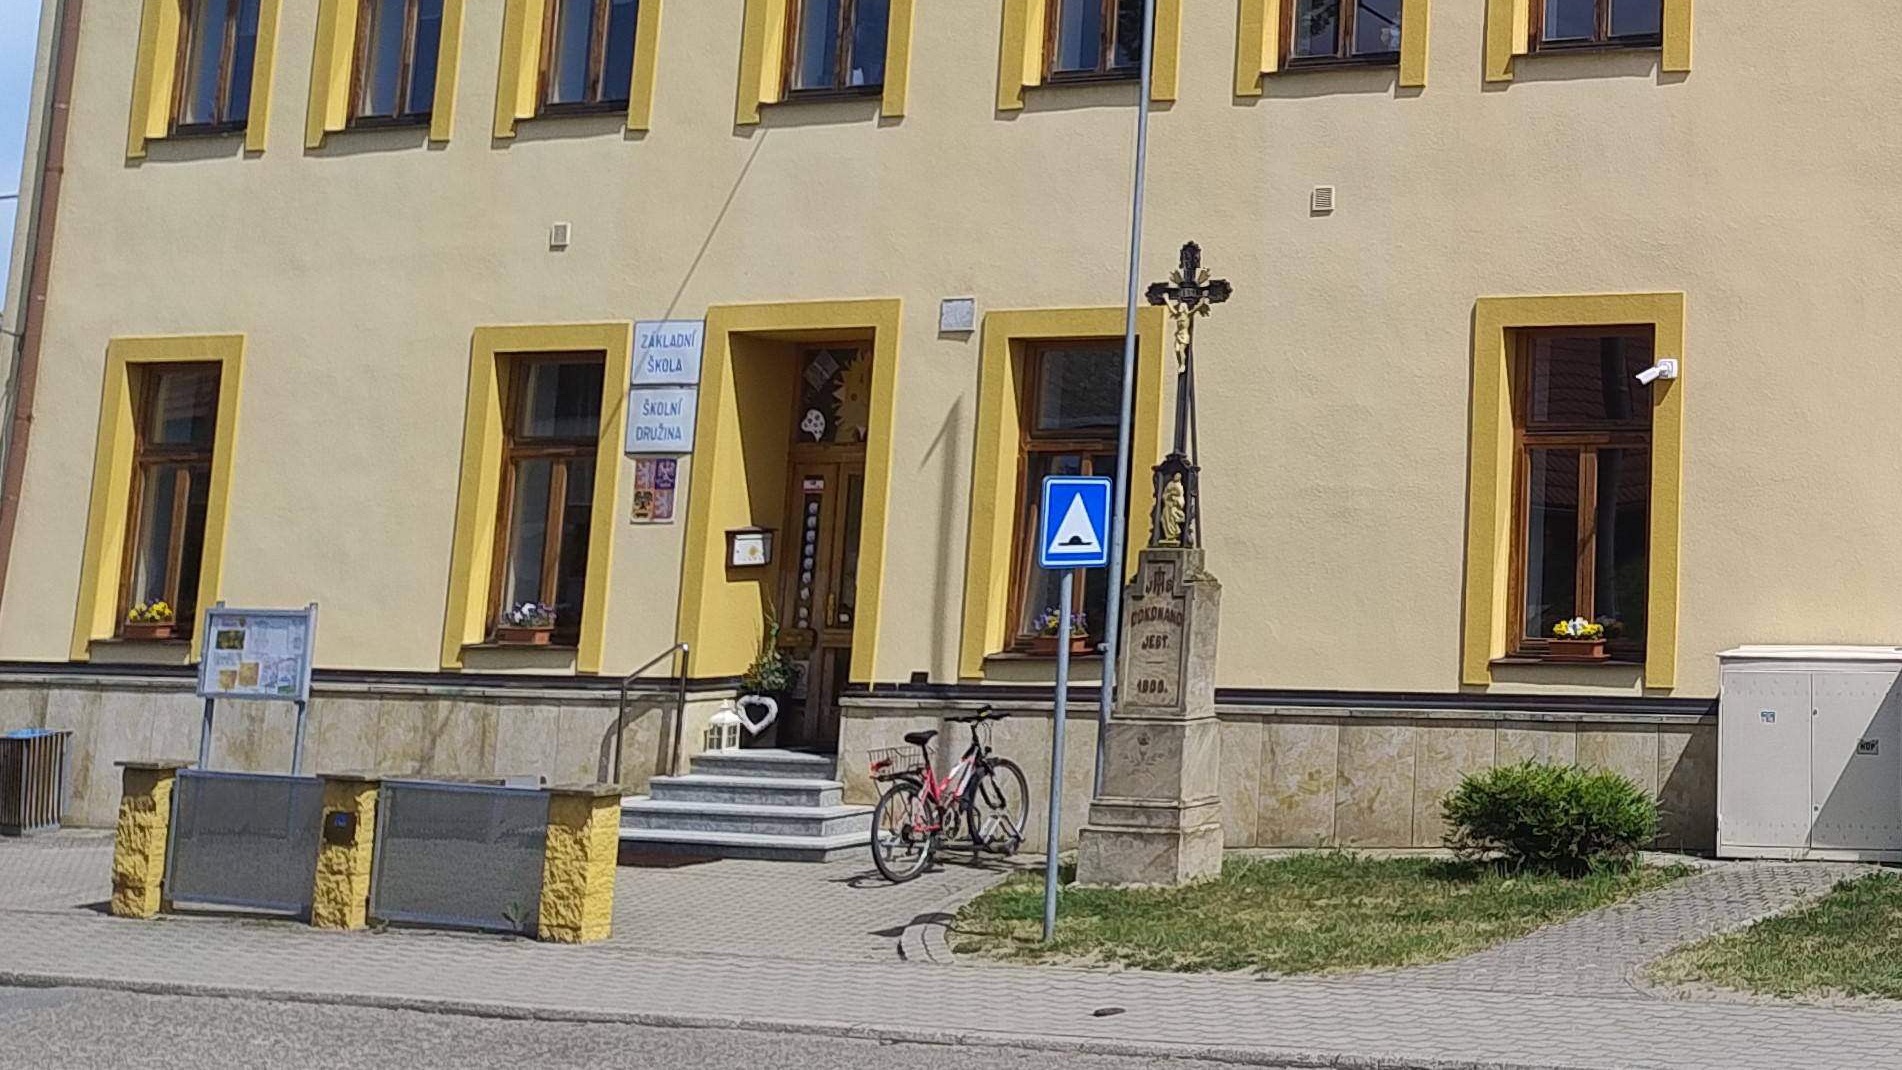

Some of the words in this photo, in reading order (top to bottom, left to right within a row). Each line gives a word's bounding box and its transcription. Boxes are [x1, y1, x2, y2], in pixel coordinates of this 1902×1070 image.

[640, 330, 697, 349] ZÁKLADNÍ
[646, 355, 683, 373] ŠKOLA
[642, 397, 683, 417] ŠKOLNÍ
[635, 422, 682, 442] DRUŽINA
